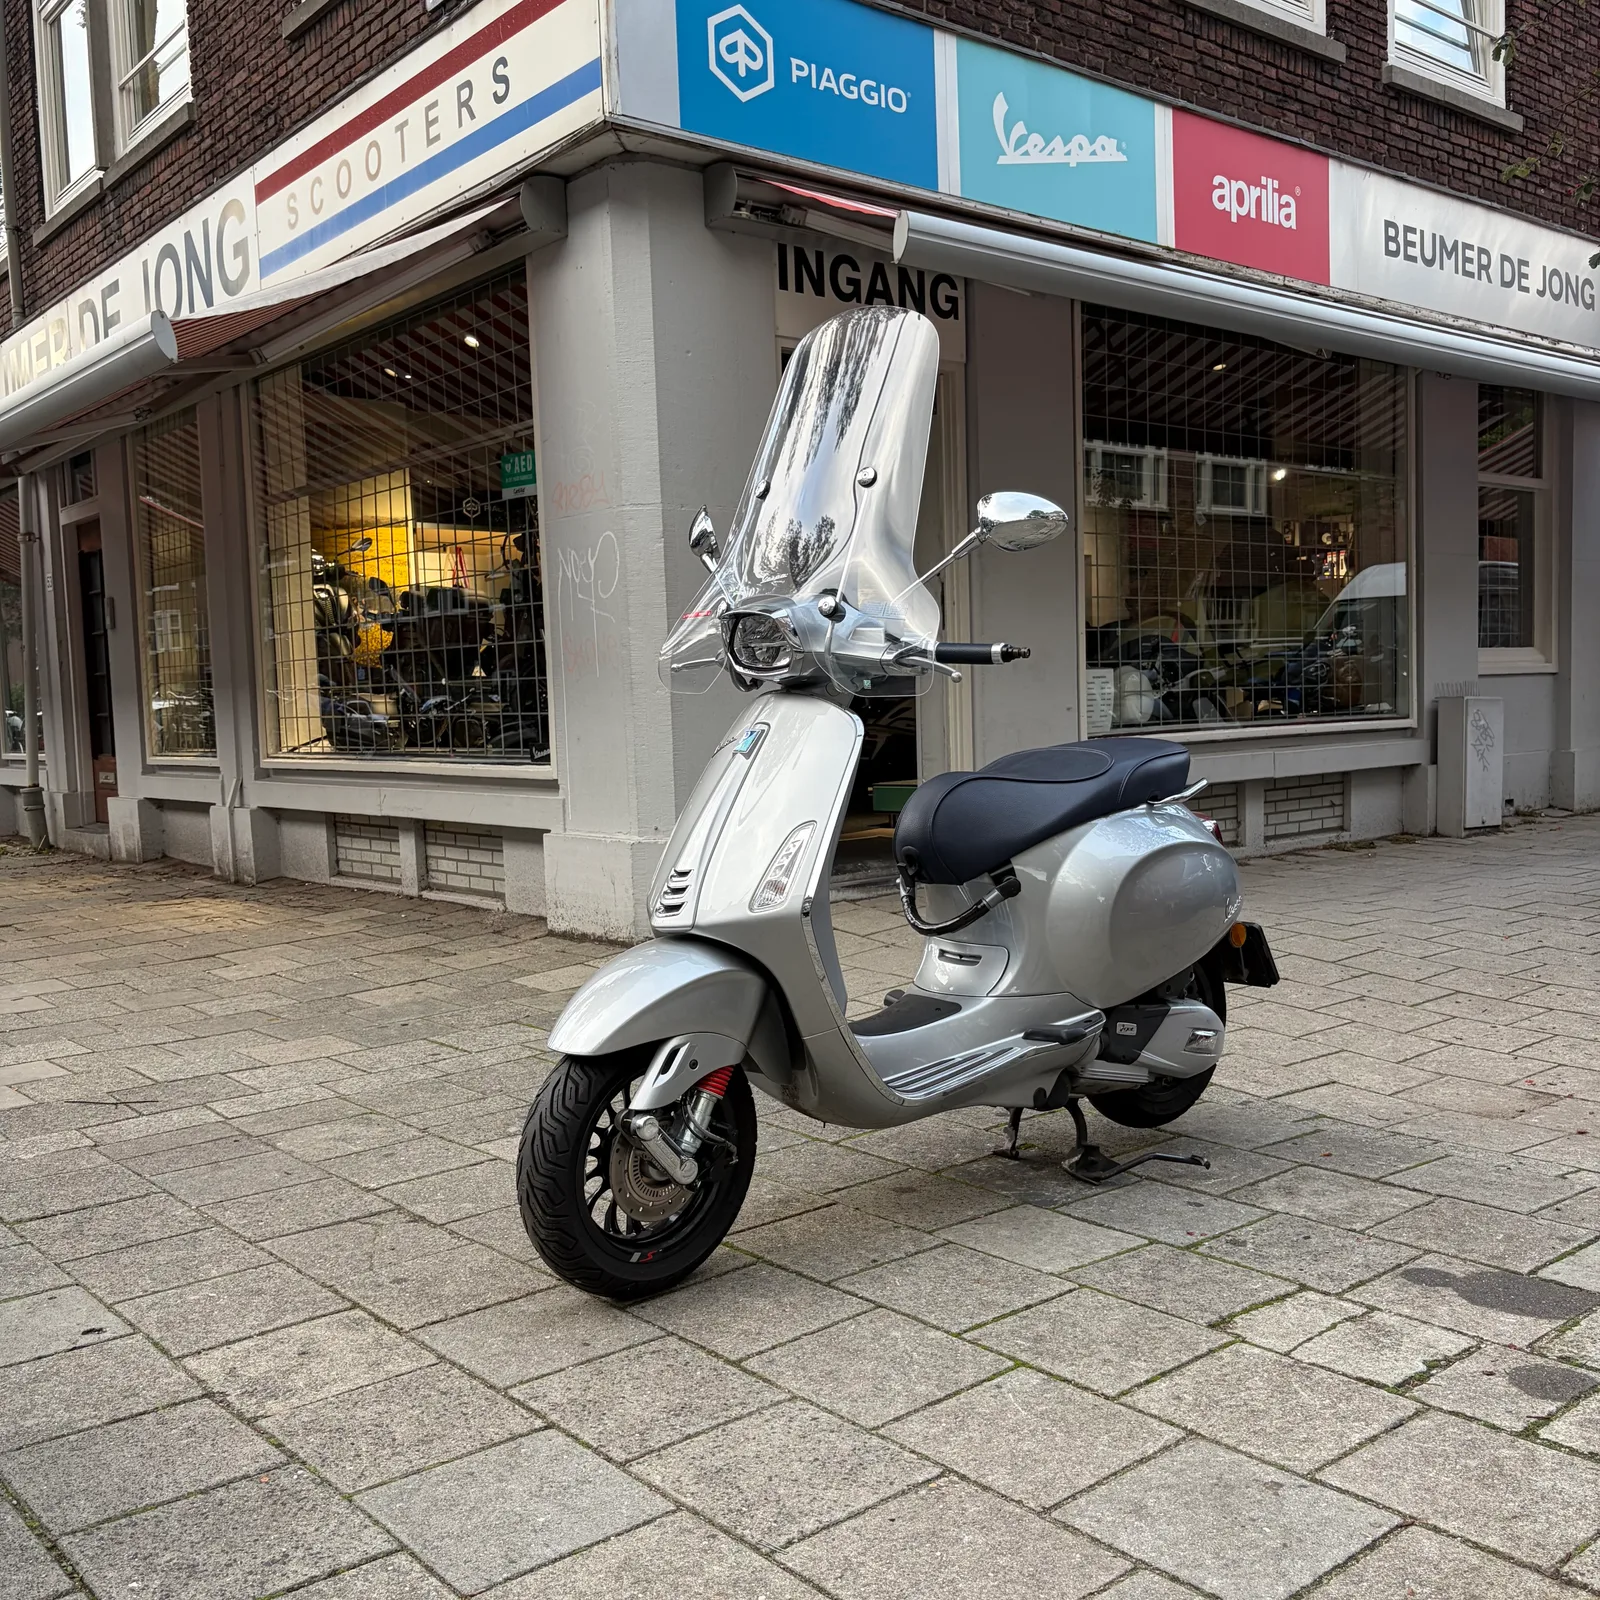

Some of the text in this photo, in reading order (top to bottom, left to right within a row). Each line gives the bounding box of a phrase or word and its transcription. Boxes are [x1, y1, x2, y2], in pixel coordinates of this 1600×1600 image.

[790, 57, 907, 113] PIAGGIO
[286, 56, 511, 230] SCOOTERS
[992, 91, 1128, 167] Vespa
[1212, 174, 1297, 230] aprilia
[142, 198, 251, 321] JONG
[777, 242, 960, 321] INGANG
[1383, 219, 1596, 311] BEUMER DE JONG
[514, 454, 533, 474] AED
